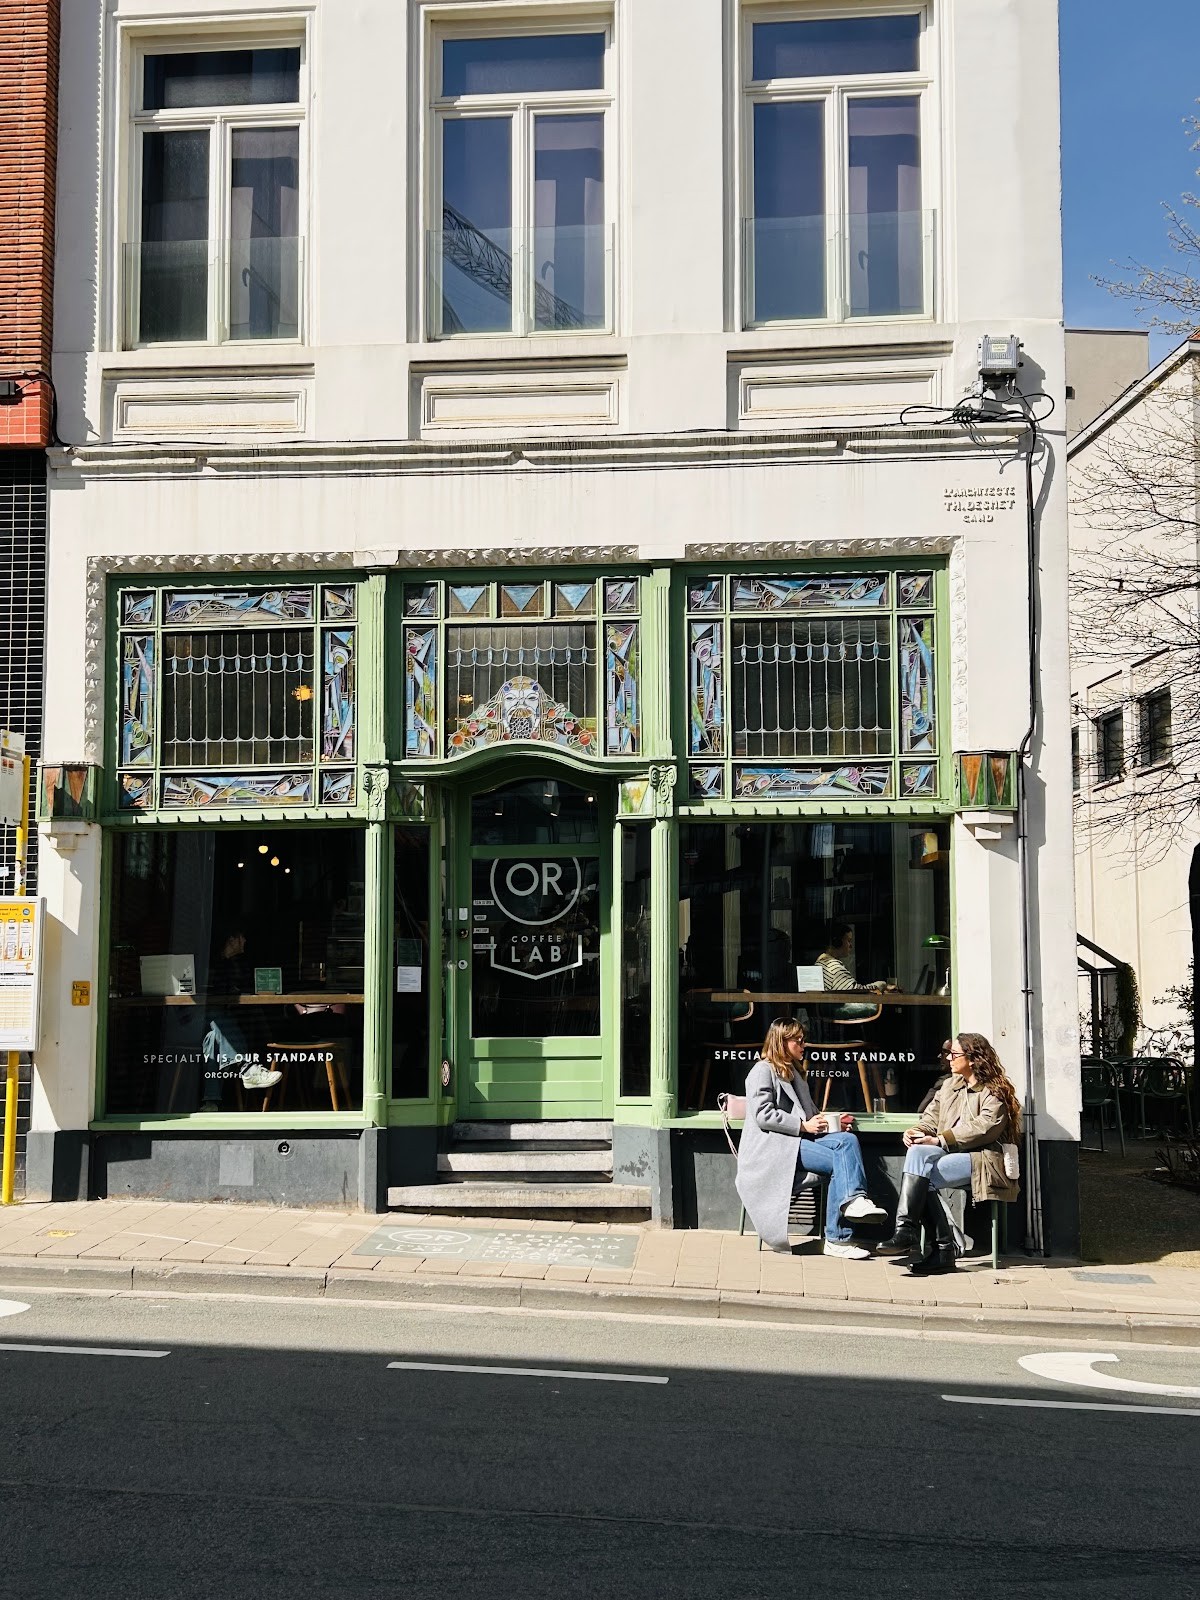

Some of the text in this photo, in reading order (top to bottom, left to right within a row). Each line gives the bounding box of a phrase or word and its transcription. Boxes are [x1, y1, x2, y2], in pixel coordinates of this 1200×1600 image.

[505, 862, 563, 897] OR
[511, 935, 562, 943] COFFEE
[511, 945, 562, 963] LAB
[143, 1052, 335, 1064] SPECIALTY IS OUR STANDARD
[714, 1050, 761, 1060] SPECIA
[810, 1051, 838, 1061] OUR
[844, 1052, 916, 1062] STANDARD
[402, 1233, 455, 1242] OR
